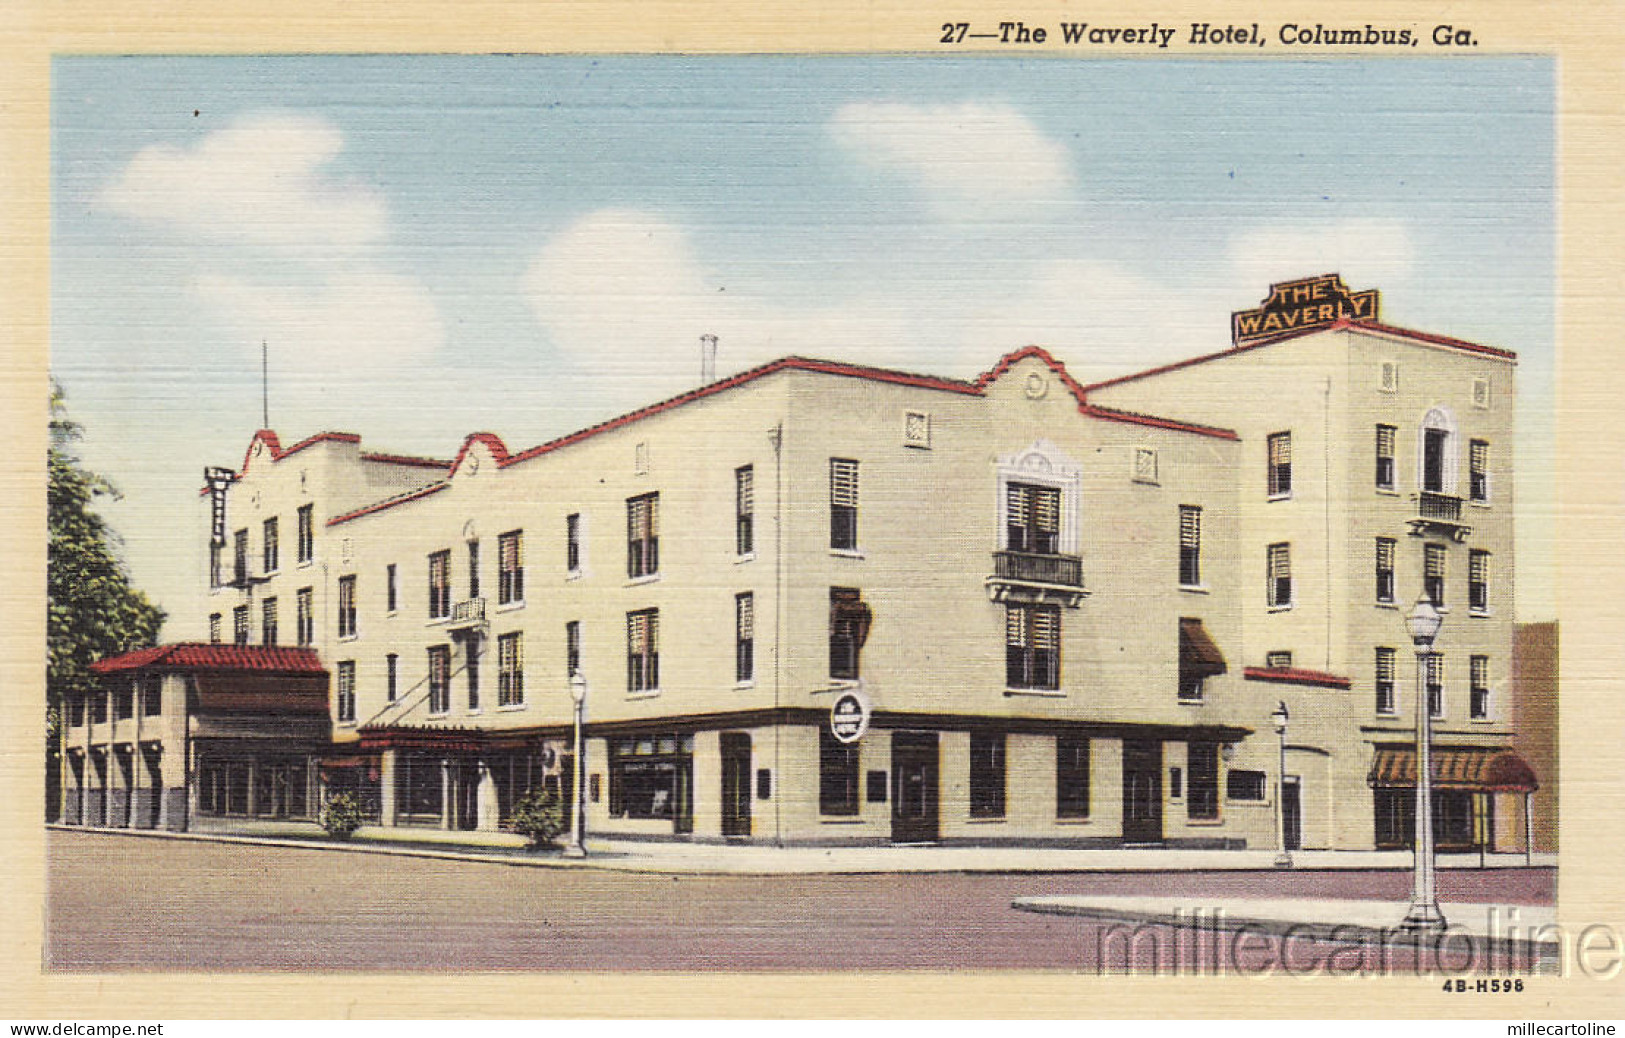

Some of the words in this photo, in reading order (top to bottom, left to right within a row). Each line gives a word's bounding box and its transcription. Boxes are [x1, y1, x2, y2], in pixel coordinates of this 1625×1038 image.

[1060, 22, 1175, 48] Waverly
[1189, 23, 1266, 48] Hotel,
[1278, 24, 1418, 47] Columbus,
[1432, 25, 1478, 46] Ga.
[1275, 282, 1329, 305] THE
[1238, 297, 1368, 335] WAVERLY
[1442, 979, 1525, 993] 4B-H598
